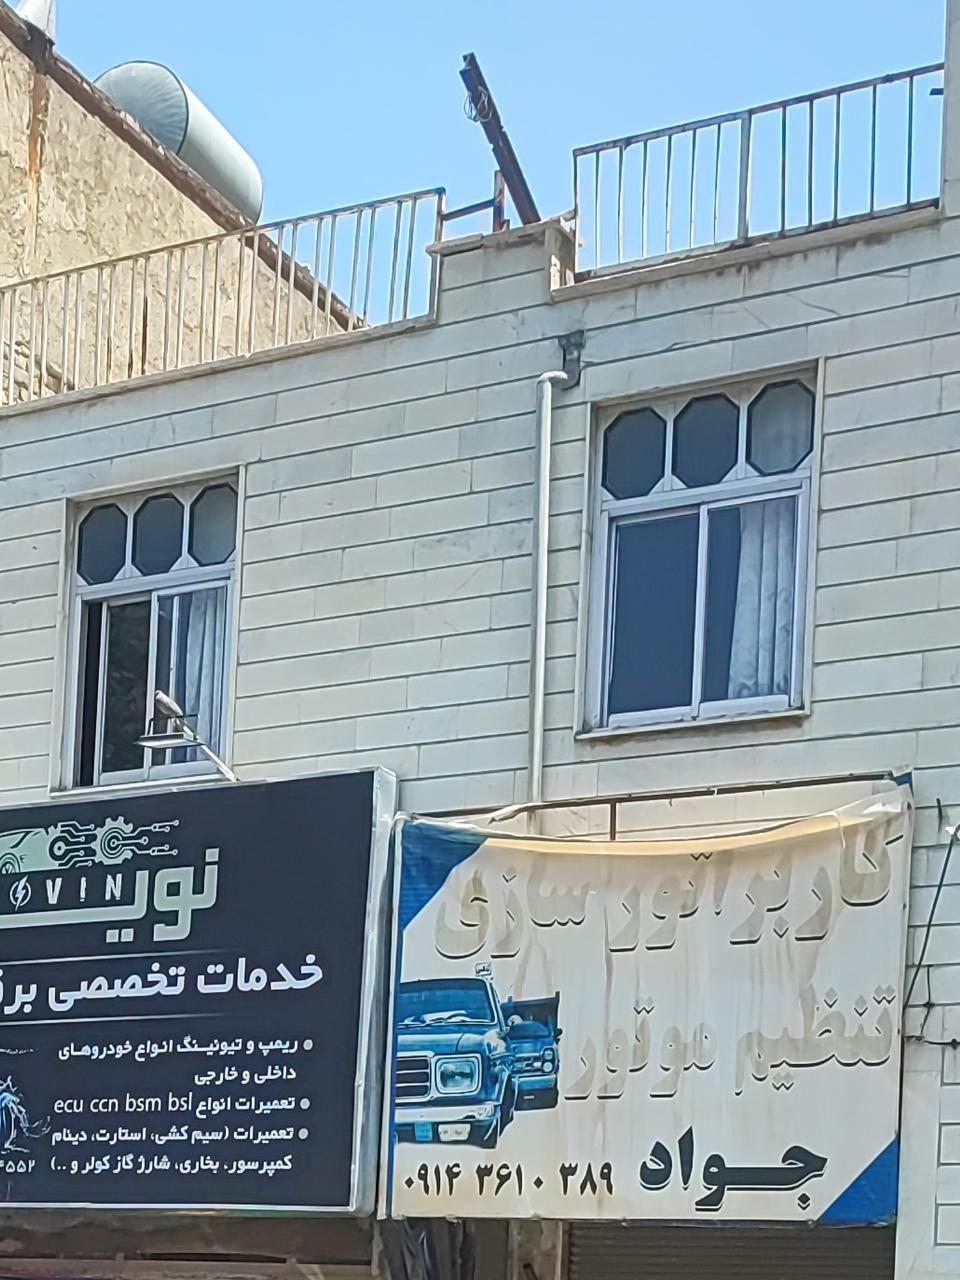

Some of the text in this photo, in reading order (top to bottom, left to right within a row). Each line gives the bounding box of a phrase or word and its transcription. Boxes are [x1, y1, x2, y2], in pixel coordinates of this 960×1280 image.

[196, 953, 323, 994] خدمات
[48, 963, 186, 1011] تخصصی
[58, 1035, 299, 1062] ریمپ و تیونینگ انواع خودروهای
[194, 1065, 297, 1086] داخلی و خارجی
[54, 1099, 84, 1113] ecu
[89, 1098, 119, 1113] ccn
[125, 1092, 162, 1112] bsm
[195, 1096, 231, 1119] انواع
[234, 1096, 296, 1114] تعمیرات
[51, 1127, 88, 1146] دینام
[233, 1125, 294, 1144] تعمیرات
[70, 1160, 79, 1175] و
[82, 1154, 111, 1175] کولر
[112, 1153, 134, 1174] گاز
[136, 1154, 171, 1174] شارژ
[640, 1126, 828, 1211] جواد
[404, 1162, 462, 1196] ۰۹۱۴
[559, 1162, 613, 1196] ۳۸۹
